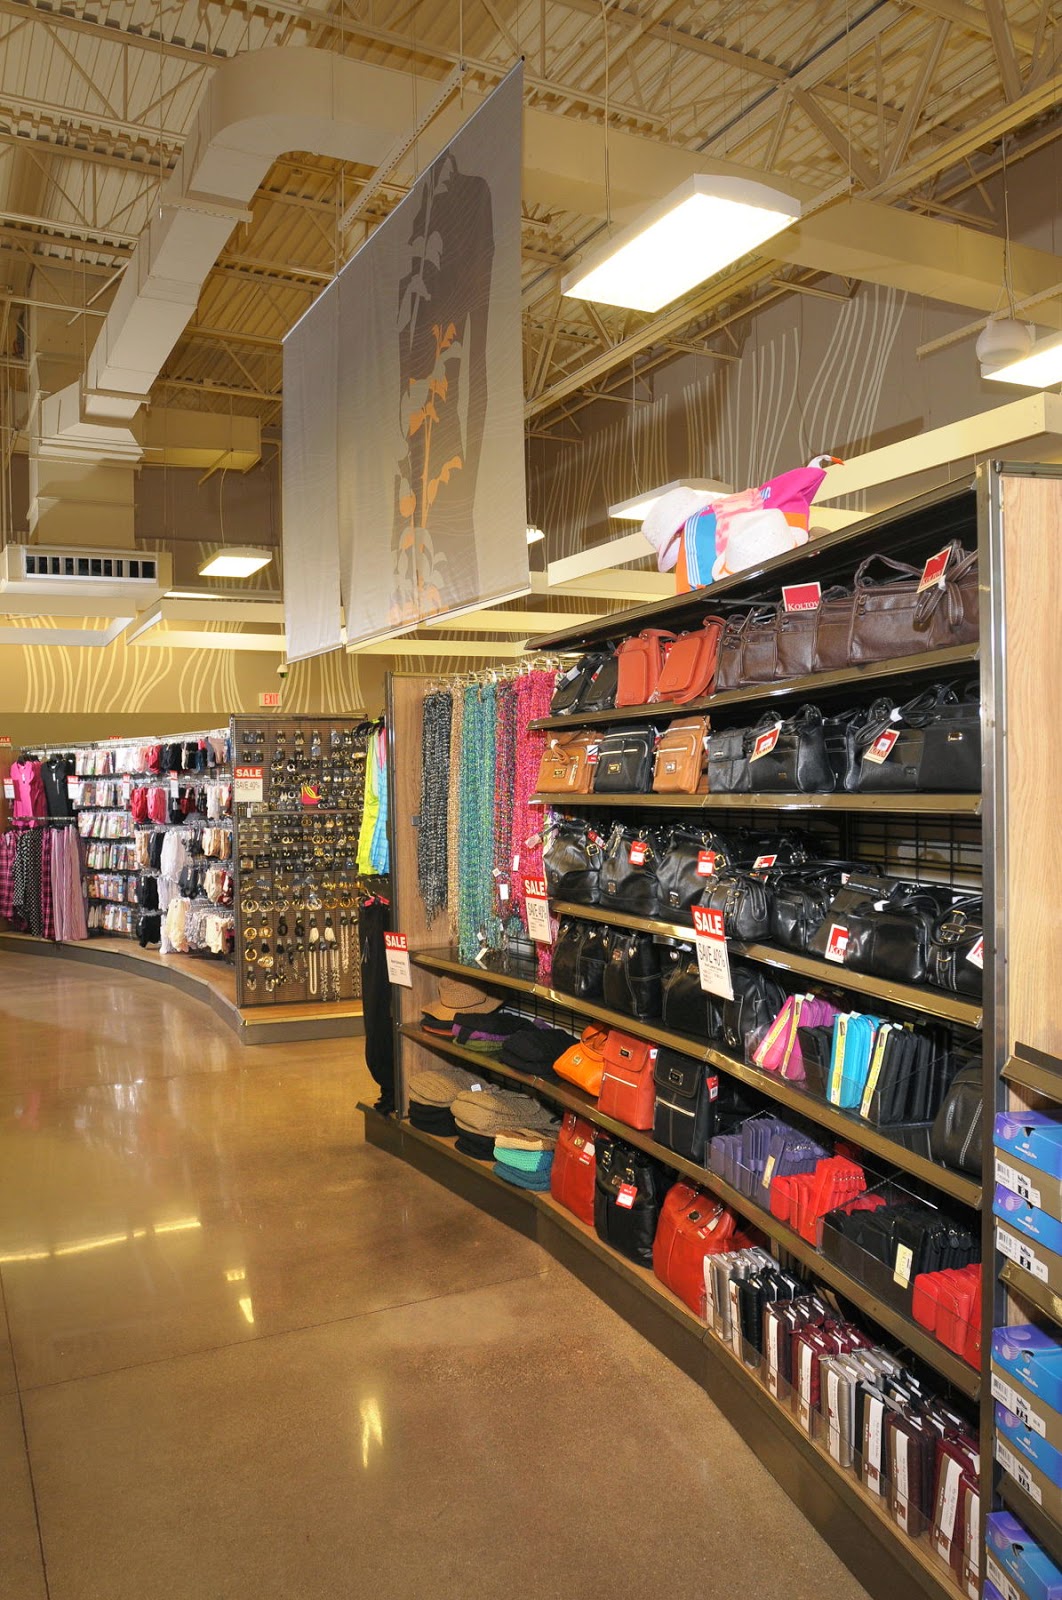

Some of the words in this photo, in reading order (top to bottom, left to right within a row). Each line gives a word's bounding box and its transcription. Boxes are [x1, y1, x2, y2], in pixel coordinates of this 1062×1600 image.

[264, 693, 279, 705] EXIT
[236, 768, 262, 778] SALE
[236, 781, 249, 789] SAVE
[524, 879, 546, 896] SALE
[694, 911, 723, 936] SALE
[385, 935, 407, 949] SALE
[698, 943, 713, 964] SAVE
